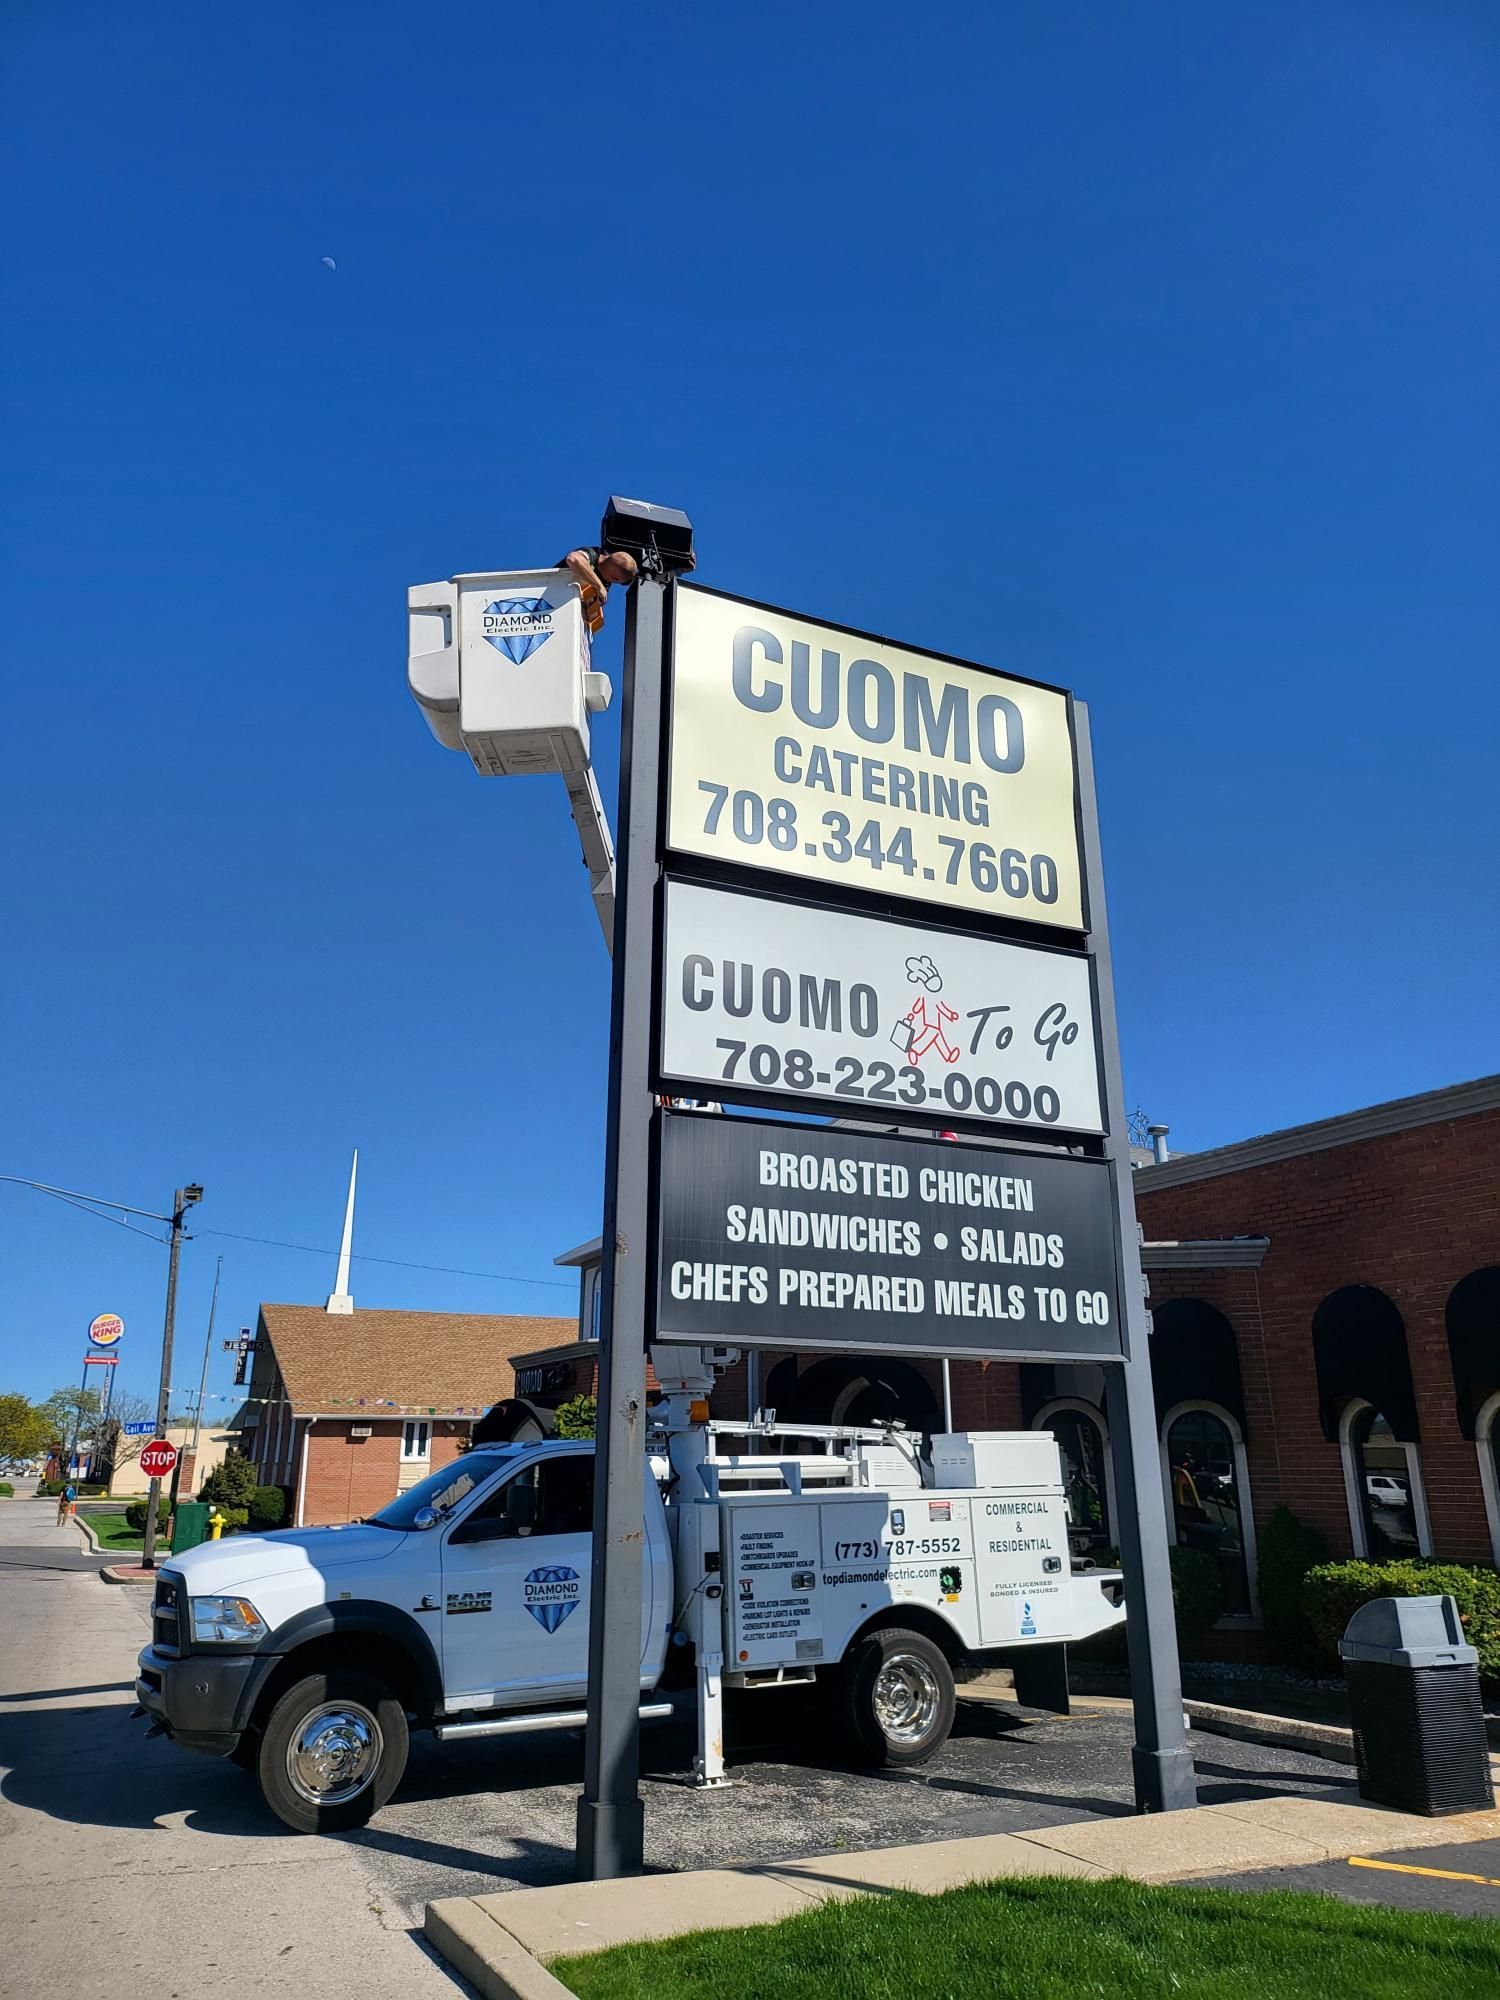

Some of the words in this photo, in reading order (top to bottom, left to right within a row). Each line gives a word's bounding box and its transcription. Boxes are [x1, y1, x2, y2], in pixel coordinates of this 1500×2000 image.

[483, 614, 552, 628] DIAMOND
[732, 626, 1026, 775] CUOMO
[774, 735, 990, 827] CATERING
[698, 780, 1059, 905] 708.344.7660
[682, 953, 879, 1038] CUOMO
[966, 1005, 1014, 1055] To
[1034, 1002, 1079, 1062] Go
[715, 1038, 1061, 1123] 708-223-0000
[759, 1149, 910, 1199] BROASTED
[919, 1167, 1034, 1212] CHICKEN
[726, 1204, 921, 1257] SANDWICHES
[960, 1226, 1065, 1268] SALADS
[670, 1260, 769, 1304] CHEFS
[779, 1268, 925, 1313] PREPARED
[934, 1280, 1025, 1321] MEALS
[1034, 1287, 1067, 1323] TO
[1075, 1290, 1109, 1326] GO
[92, 1319, 121, 1330] BURGER
[92, 1325, 121, 1339] KING
[225, 1341, 263, 1351] JESUS
[125, 1425, 140, 1434] Gail
[142, 1423, 156, 1433] Ave
[141, 1451, 176, 1466] STOP
[985, 1502, 1049, 1516] COMMERCIAL
[1015, 1520, 1023, 1533] &
[835, 1540, 878, 1561] (773)
[885, 1538, 961, 1556] 787-5552
[989, 1538, 1052, 1553] RESIDENTIAL
[822, 1568, 938, 1587] topdiamondelectric.com
[995, 1582, 1017, 1590] FULLY
[1018, 1580, 1053, 1588] LICENSED
[524, 1583, 579, 1596] DIAMOND
[990, 1590, 1020, 1598] BONDED
[1028, 1587, 1059, 1595] INSURED
[527, 1594, 560, 1602] Electric
